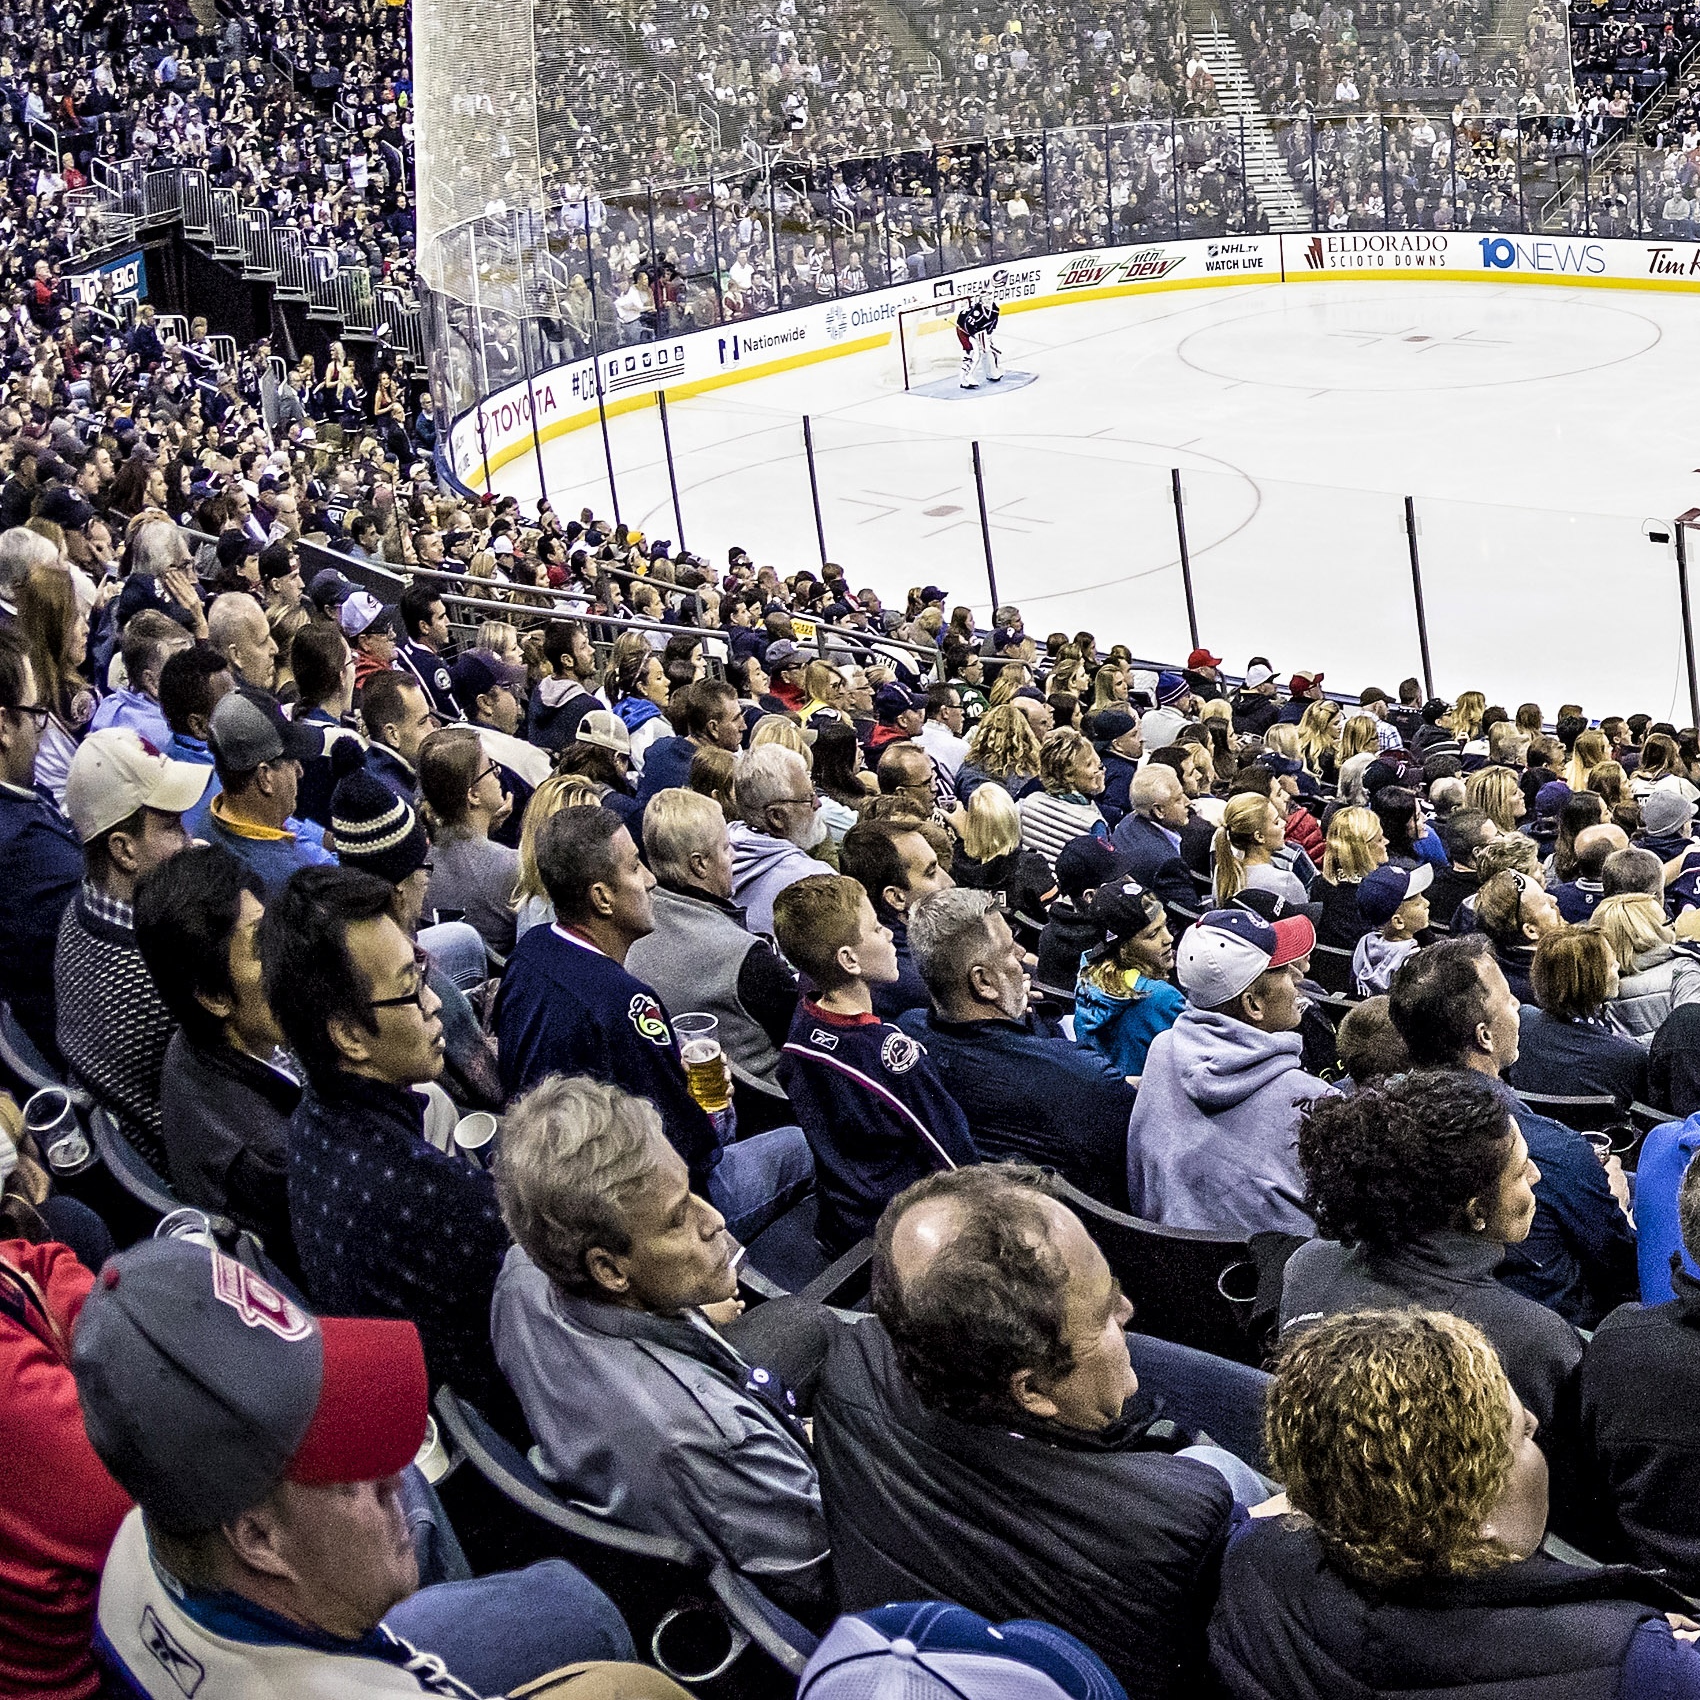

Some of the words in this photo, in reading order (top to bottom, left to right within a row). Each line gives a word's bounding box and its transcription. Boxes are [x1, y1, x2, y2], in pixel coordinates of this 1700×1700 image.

[1327, 236, 1448, 253] ELDORADO
[1205, 259, 1240, 271] WATCH
[1242, 257, 1264, 269] LIVE
[1330, 254, 1384, 267] SCIOTO
[1395, 254, 1446, 267] DOWNS
[1647, 248, 1684, 276] Tim
[1010, 270, 1041, 285] GAMES
[1024, 284, 1036, 296] GO
[743, 327, 806, 353] Nationwide
[491, 386, 557, 437] TOYOTA
